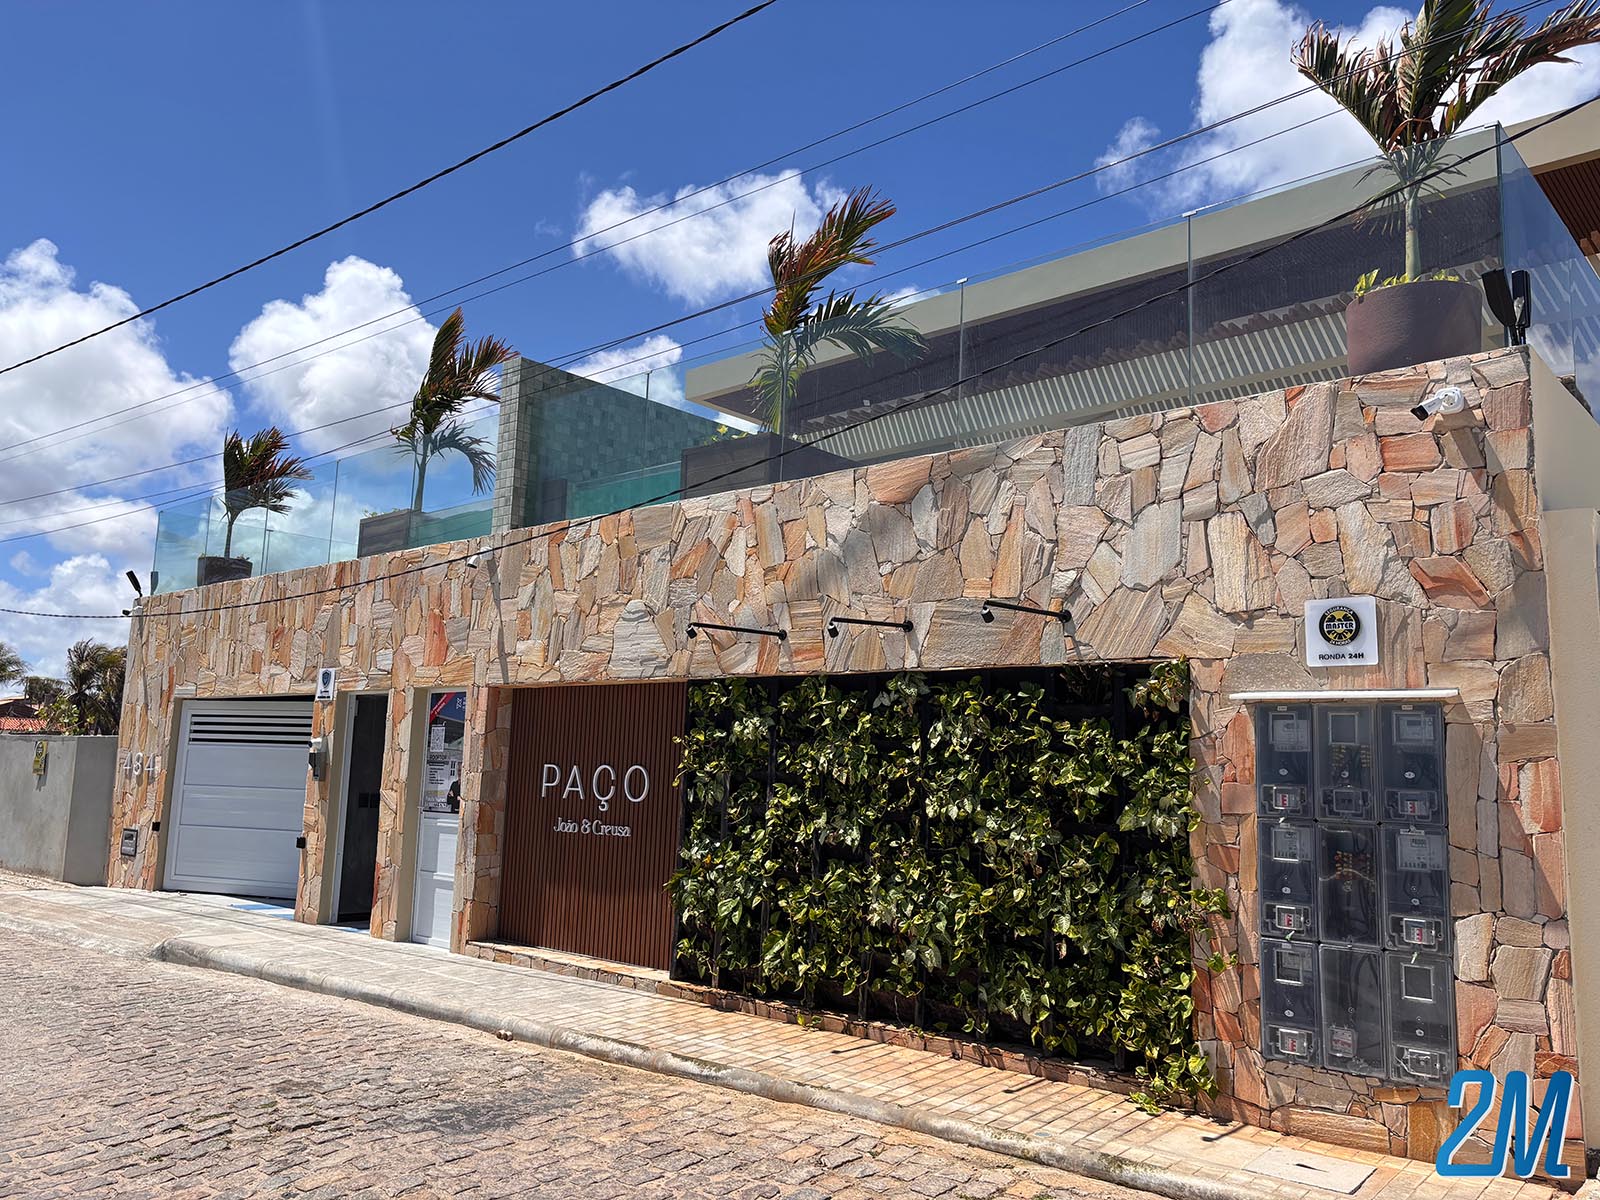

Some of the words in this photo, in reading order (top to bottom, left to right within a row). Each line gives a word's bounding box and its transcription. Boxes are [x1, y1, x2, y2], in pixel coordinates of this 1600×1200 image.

[1325, 622, 1354, 630] MASTER
[123, 751, 157, 775] 484
[541, 764, 650, 811] PAÇO
[553, 817, 579, 833] João
[581, 818, 592, 834] &
[592, 820, 632, 837] Creusa
